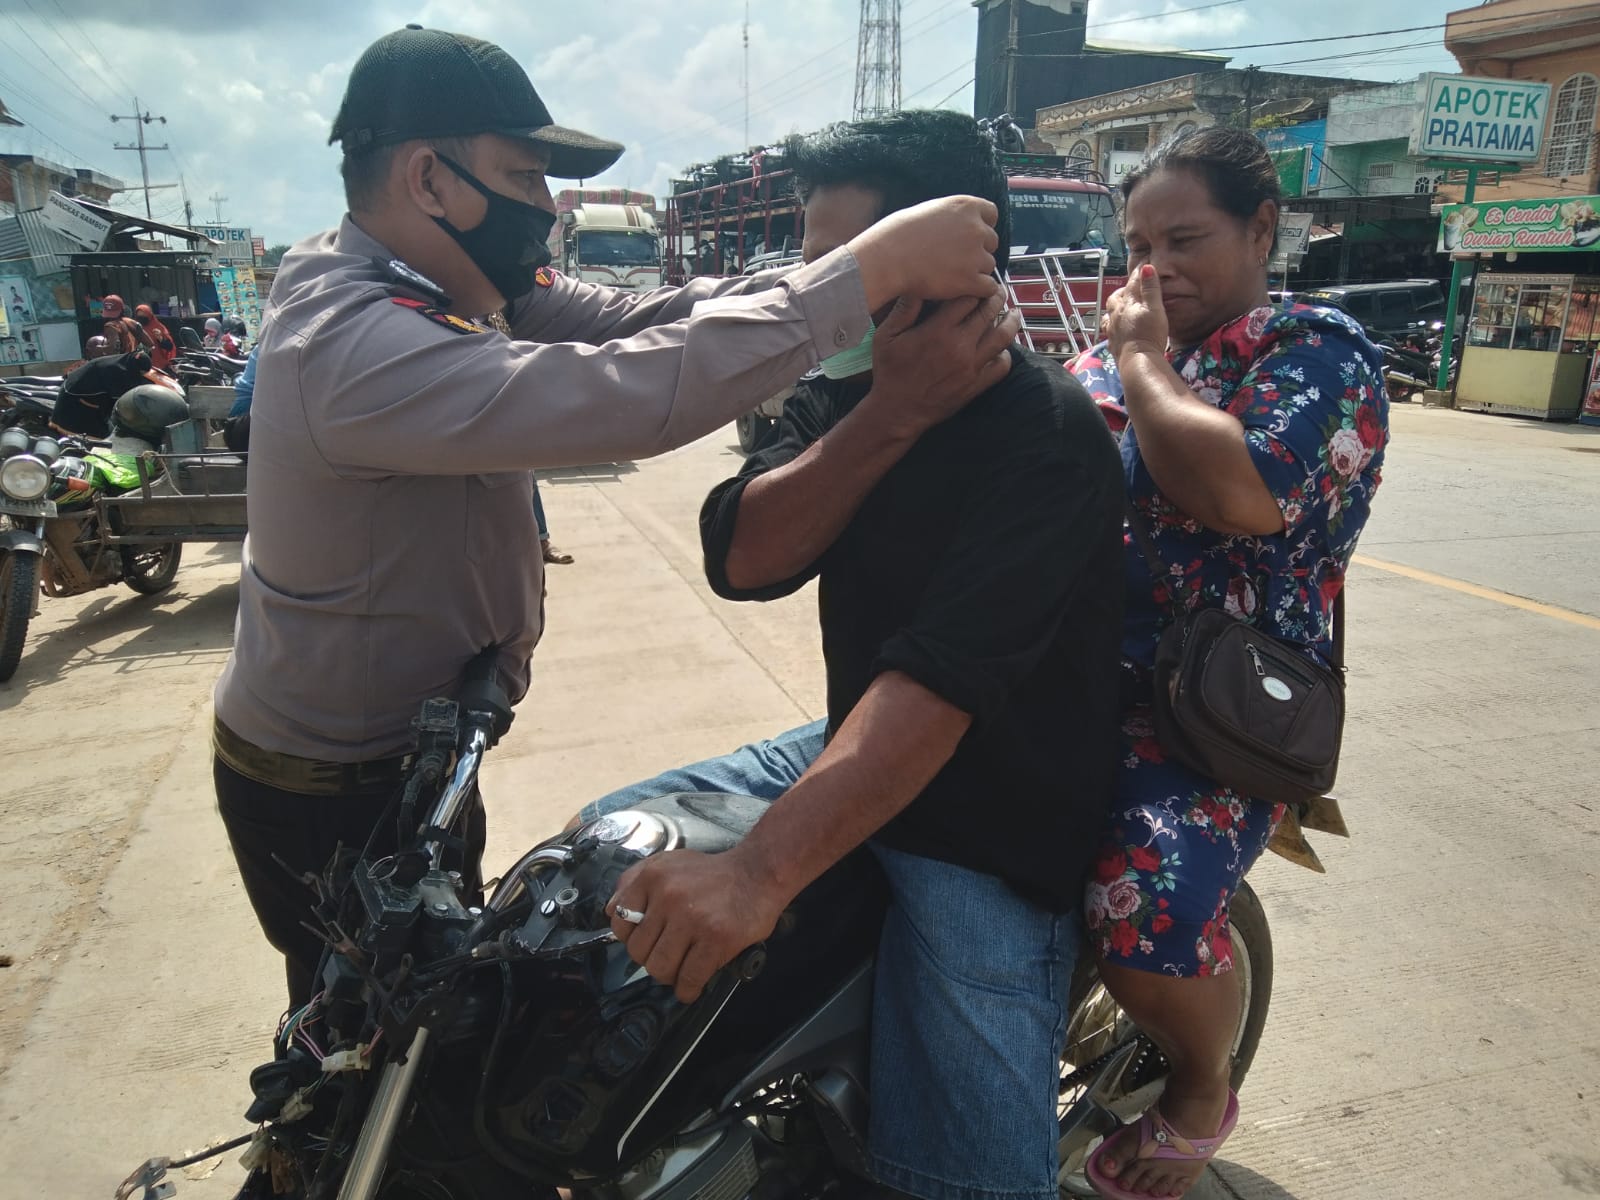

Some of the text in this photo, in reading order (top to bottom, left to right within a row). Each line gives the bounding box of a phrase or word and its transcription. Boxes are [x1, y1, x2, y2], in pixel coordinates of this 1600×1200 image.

[1434, 86, 1542, 119] APOTEK
[1428, 118, 1535, 152] PRATAMA
[80, 213, 108, 231] RAMBUT
[1485, 203, 1559, 225] Es Cendol
[204, 229, 246, 241] APOTEK
[1462, 226, 1575, 247] Durian Runtuh
